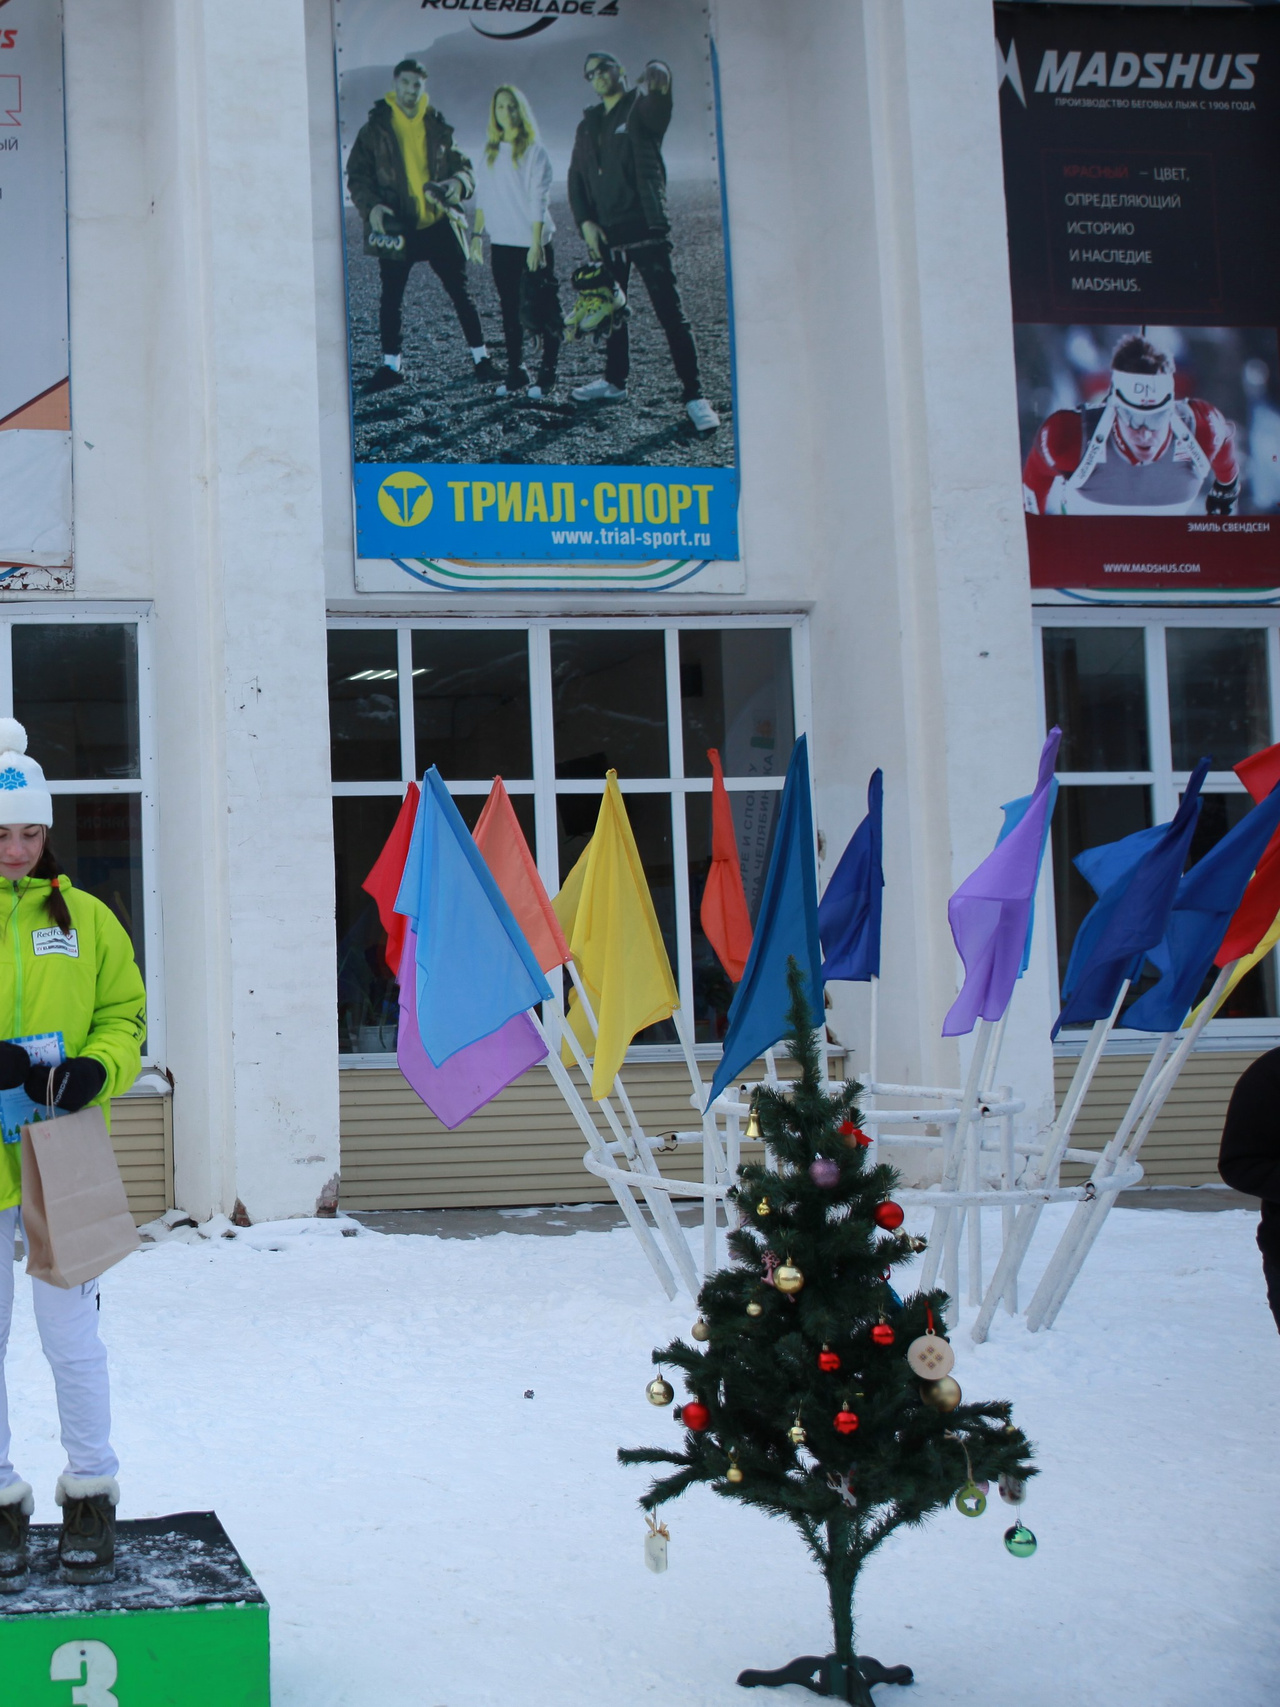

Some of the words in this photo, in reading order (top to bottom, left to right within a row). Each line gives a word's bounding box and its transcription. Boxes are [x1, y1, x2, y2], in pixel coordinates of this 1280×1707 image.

[421, 0, 596, 15] ROLLERBLADE
[1034, 50, 1260, 93] MADSHUS
[1055, 97, 1129, 108] ПРОИЗВОДСТВО
[1131, 99, 1173, 109] БЕГОВЫХ
[1175, 100, 1198, 109] ЛЫЖ
[1209, 101, 1229, 110] 1906
[1231, 102, 1256, 110] ГОДА
[1064, 165, 1128, 178] КРАСНЫЙ
[1154, 168, 1190, 182] ЦВЕТ,
[1065, 192, 1181, 209] ОПРЕДЕЛЯЮЩИЙ
[1067, 222, 1134, 235] ИСТОРИЮ
[1069, 250, 1079, 261] И
[1082, 250, 1152, 264] НАСЛЕДИЕ
[1072, 278, 1141, 292] MADSHUS.
[1187, 522, 1220, 532] ЭМИЛЬ
[1222, 523, 1269, 533] СВЕНДСЕН
[552, 528, 711, 549] www.trial-sport.ru
[1104, 563, 1200, 573] WWW.MADSHUS.COM
[54, 1072, 70, 1105] NORDSKI
[50, 1640, 119, 1707] 3
